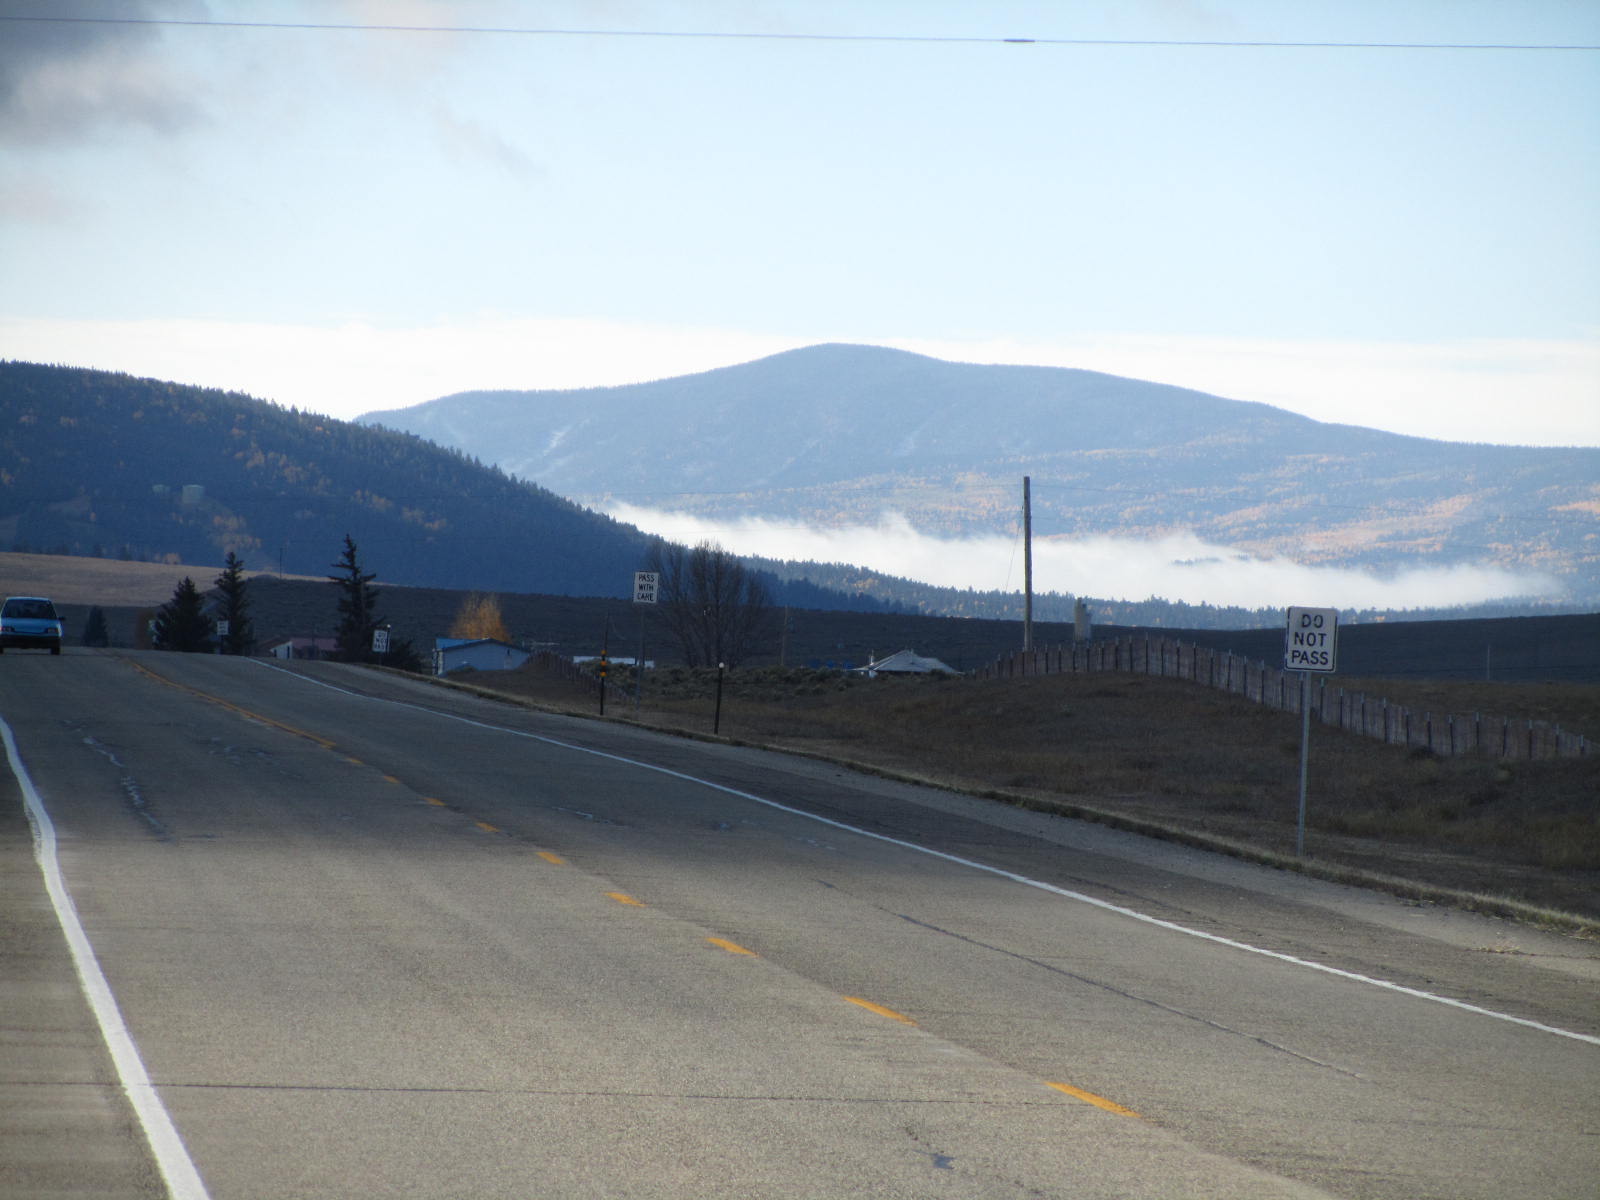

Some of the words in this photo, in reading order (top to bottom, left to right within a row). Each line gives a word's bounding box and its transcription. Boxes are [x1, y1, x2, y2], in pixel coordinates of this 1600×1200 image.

[638, 574, 655, 582] PASS
[638, 583, 654, 591] WITH
[637, 592, 654, 601] CARE
[1302, 614, 1324, 628] DO
[1294, 631, 1327, 647] NOT
[1291, 649, 1329, 665] PASS
